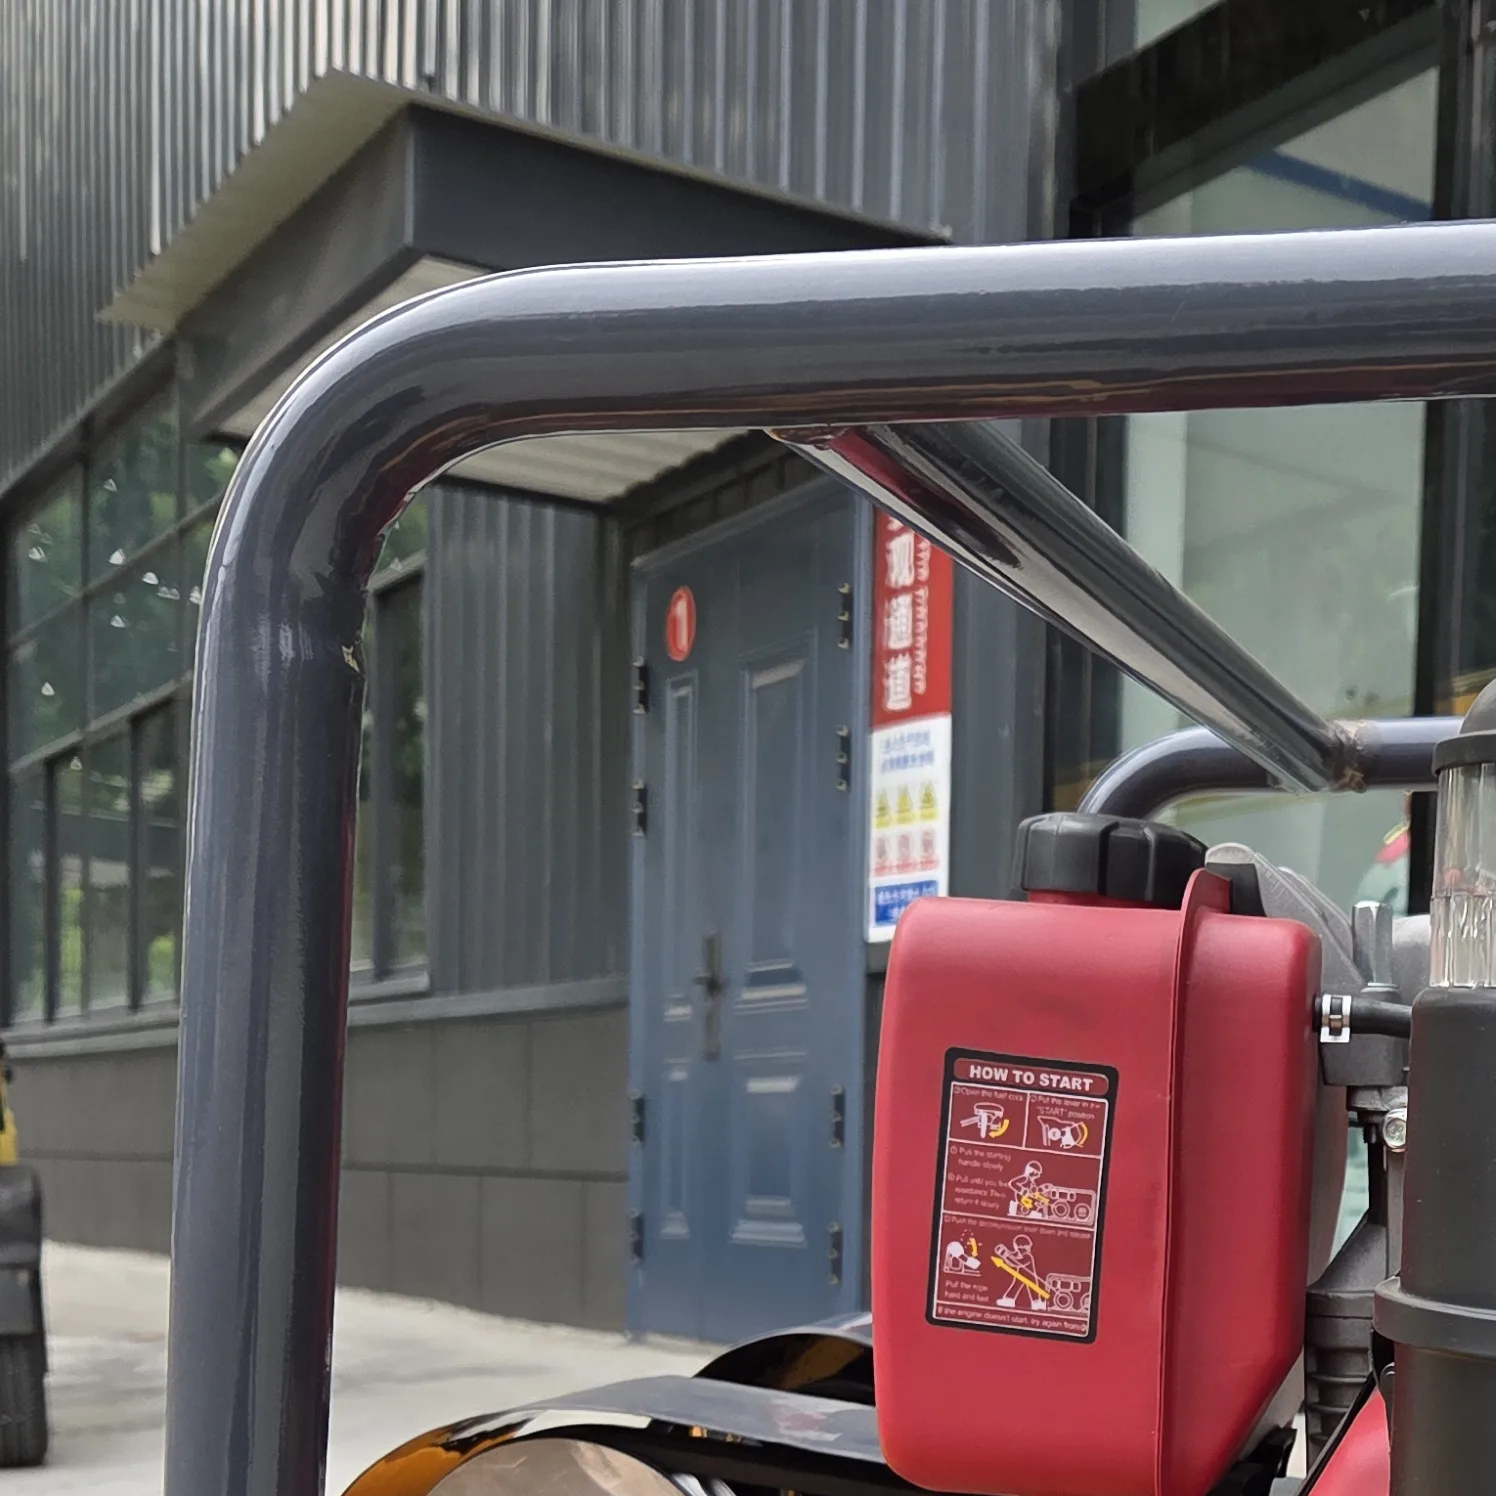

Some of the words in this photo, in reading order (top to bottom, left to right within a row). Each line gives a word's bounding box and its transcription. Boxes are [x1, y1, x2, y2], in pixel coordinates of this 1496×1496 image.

[969, 1065, 1008, 1081] HOW
[1012, 1070, 1034, 1084] TO
[1039, 1073, 1093, 1091] START
